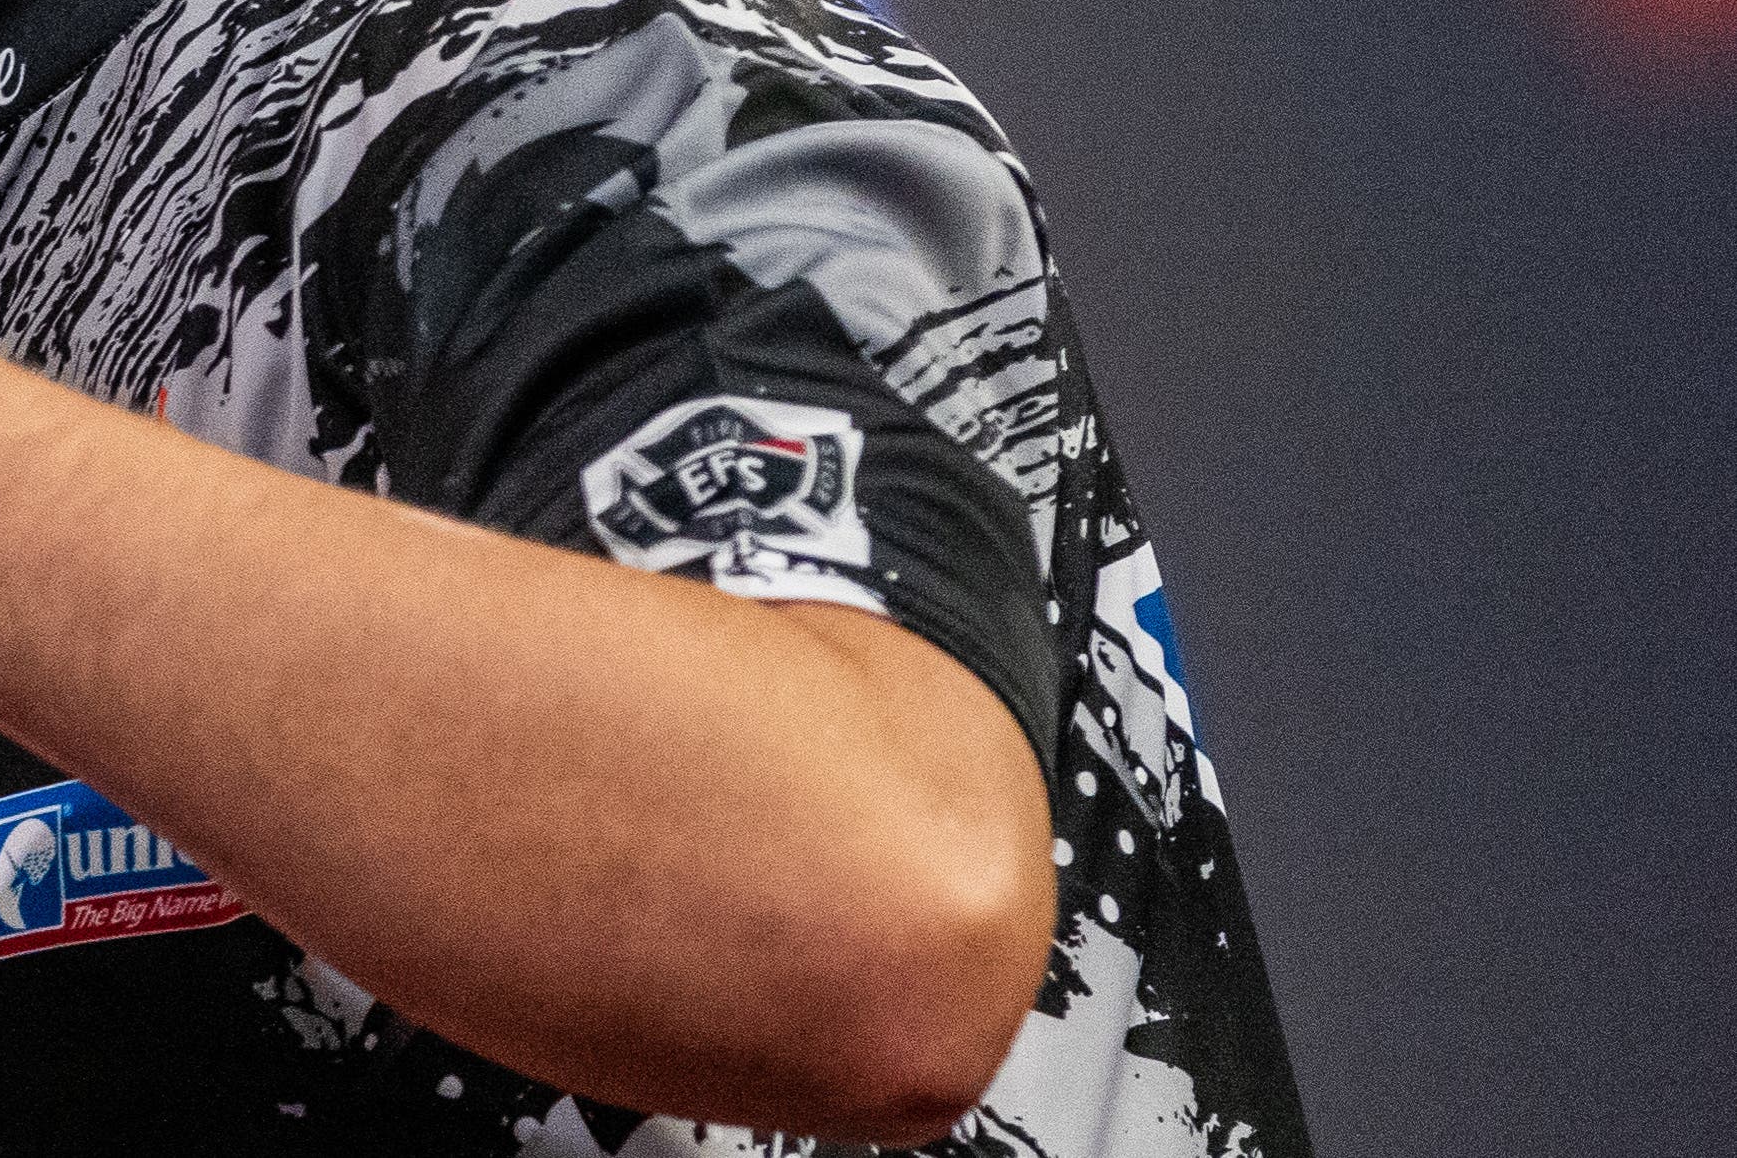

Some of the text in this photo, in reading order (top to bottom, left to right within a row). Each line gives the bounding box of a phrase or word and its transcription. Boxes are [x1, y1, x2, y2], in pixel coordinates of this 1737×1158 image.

[678, 449, 767, 506] EFS
[70, 903, 110, 930] The
[112, 896, 148, 929] Big
[149, 892, 219, 920] Name
